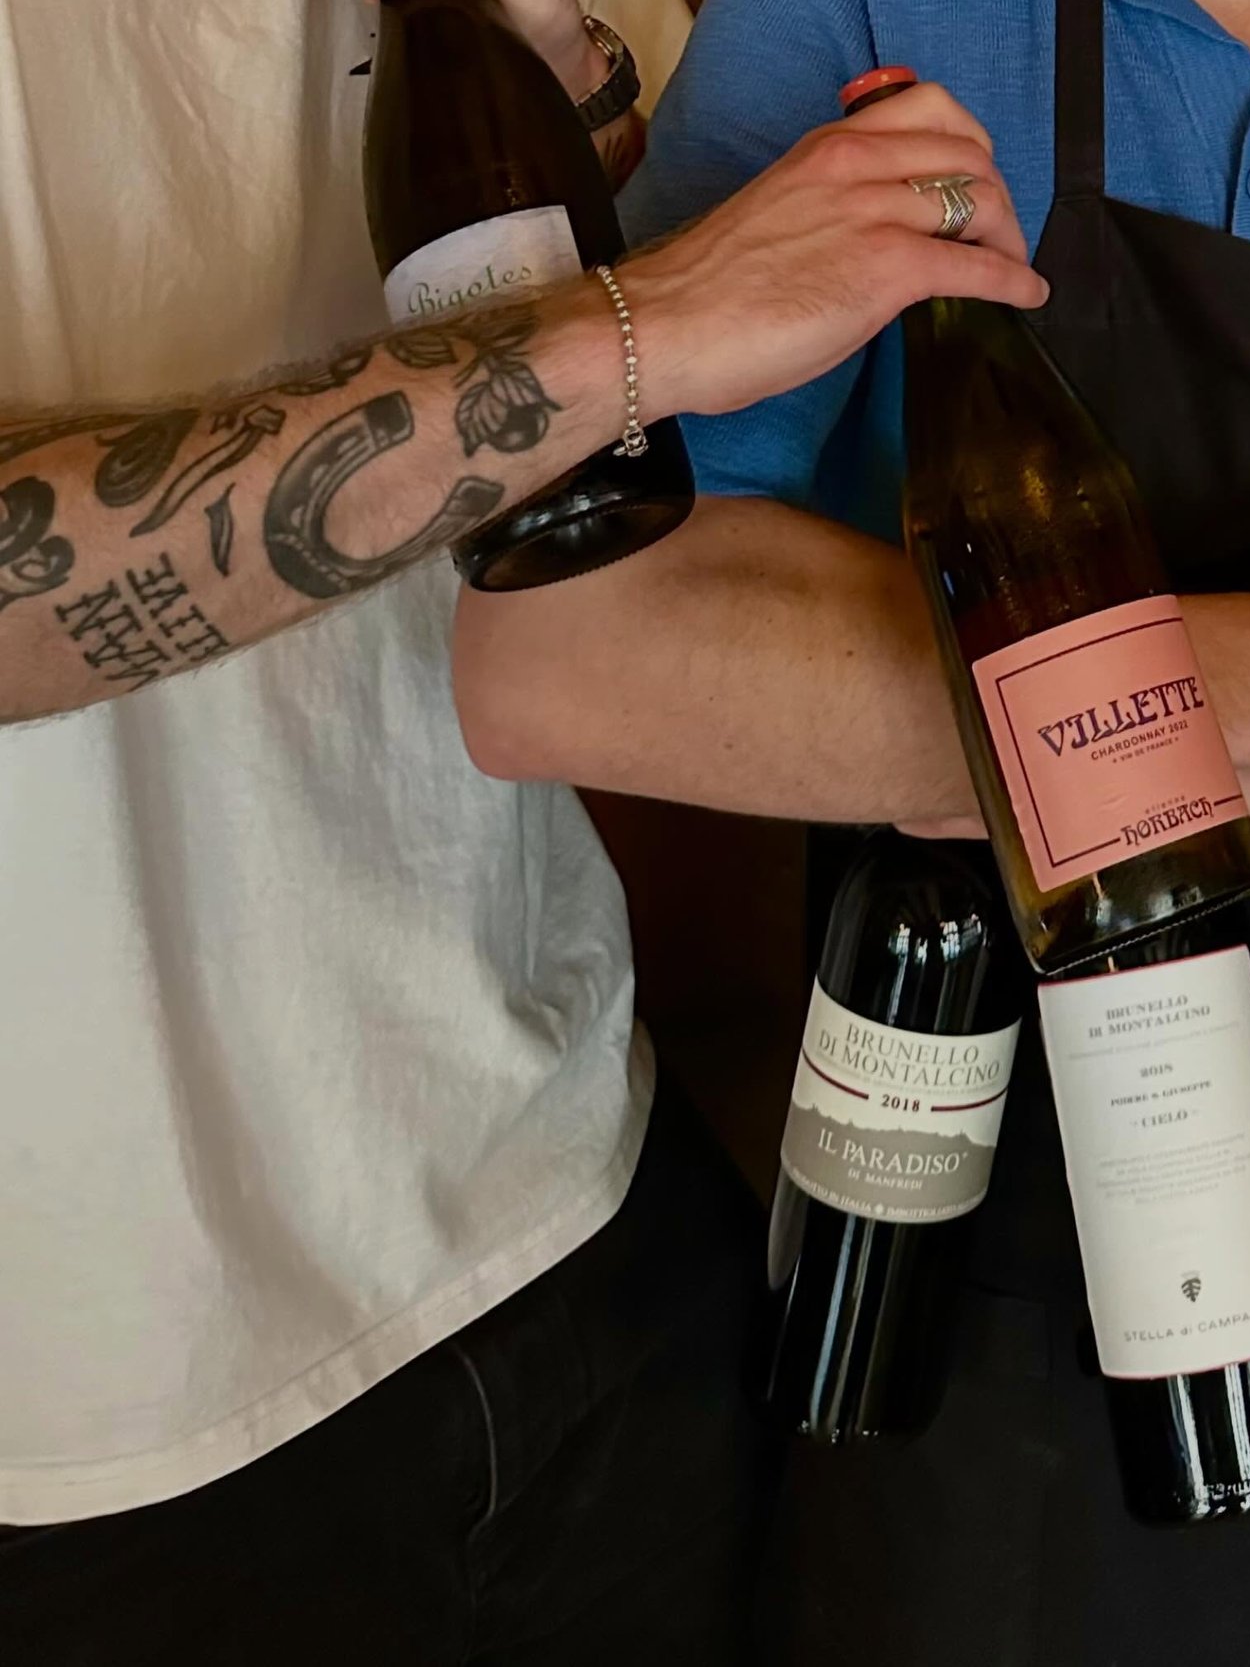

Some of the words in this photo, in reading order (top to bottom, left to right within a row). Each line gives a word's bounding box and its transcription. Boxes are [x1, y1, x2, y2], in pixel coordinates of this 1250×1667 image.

[407, 264, 533, 316] Bigotes
[1037, 676, 1205, 757] VILLETTE
[1090, 725, 1166, 762] CHARDONNAY
[1088, 1026, 1103, 1039] DI
[1108, 1006, 1211, 1036] MONTALCINO
[1106, 994, 1189, 1021] BRUNELLO
[818, 1028, 837, 1056] DI
[841, 1042, 1001, 1088] MONTALCINO
[845, 1021, 980, 1066] BRUNELLO
[881, 1093, 922, 1113] 2018
[817, 1127, 837, 1154] IL
[842, 1139, 961, 1176] PARADISO
[848, 1168, 860, 1179] DI
[865, 1172, 924, 1191] MANFREDI
[1124, 1328, 1174, 1343] STELLA
[1180, 1325, 1194, 1336] di
